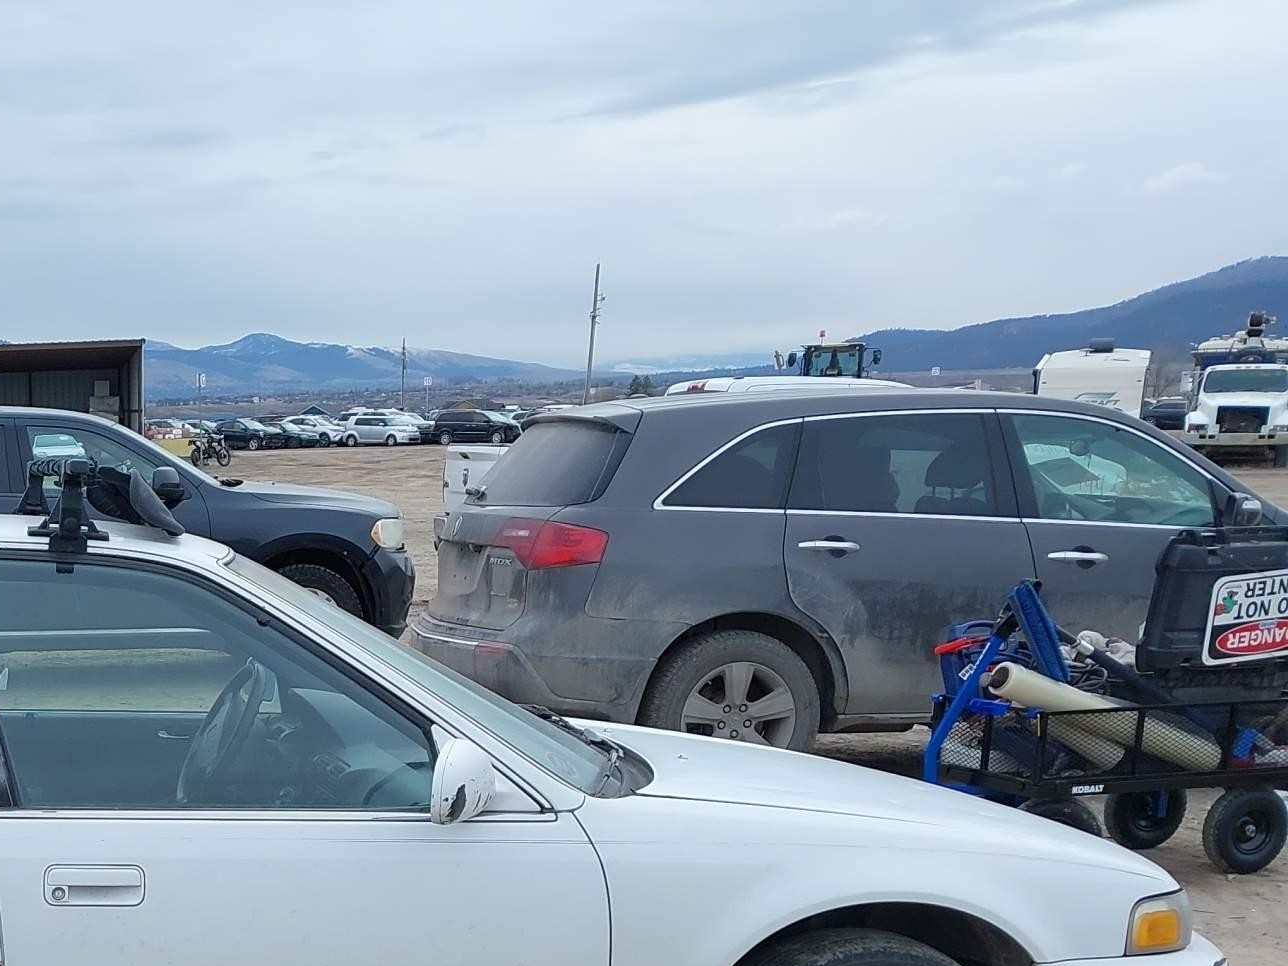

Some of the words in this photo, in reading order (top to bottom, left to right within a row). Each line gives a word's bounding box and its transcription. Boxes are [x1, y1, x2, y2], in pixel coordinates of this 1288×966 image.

[1244, 577, 1288, 598] NTER
[1233, 599, 1272, 620] NOT
[1226, 627, 1288, 649] ANGER
[1072, 784, 1105, 795] KOBALT
